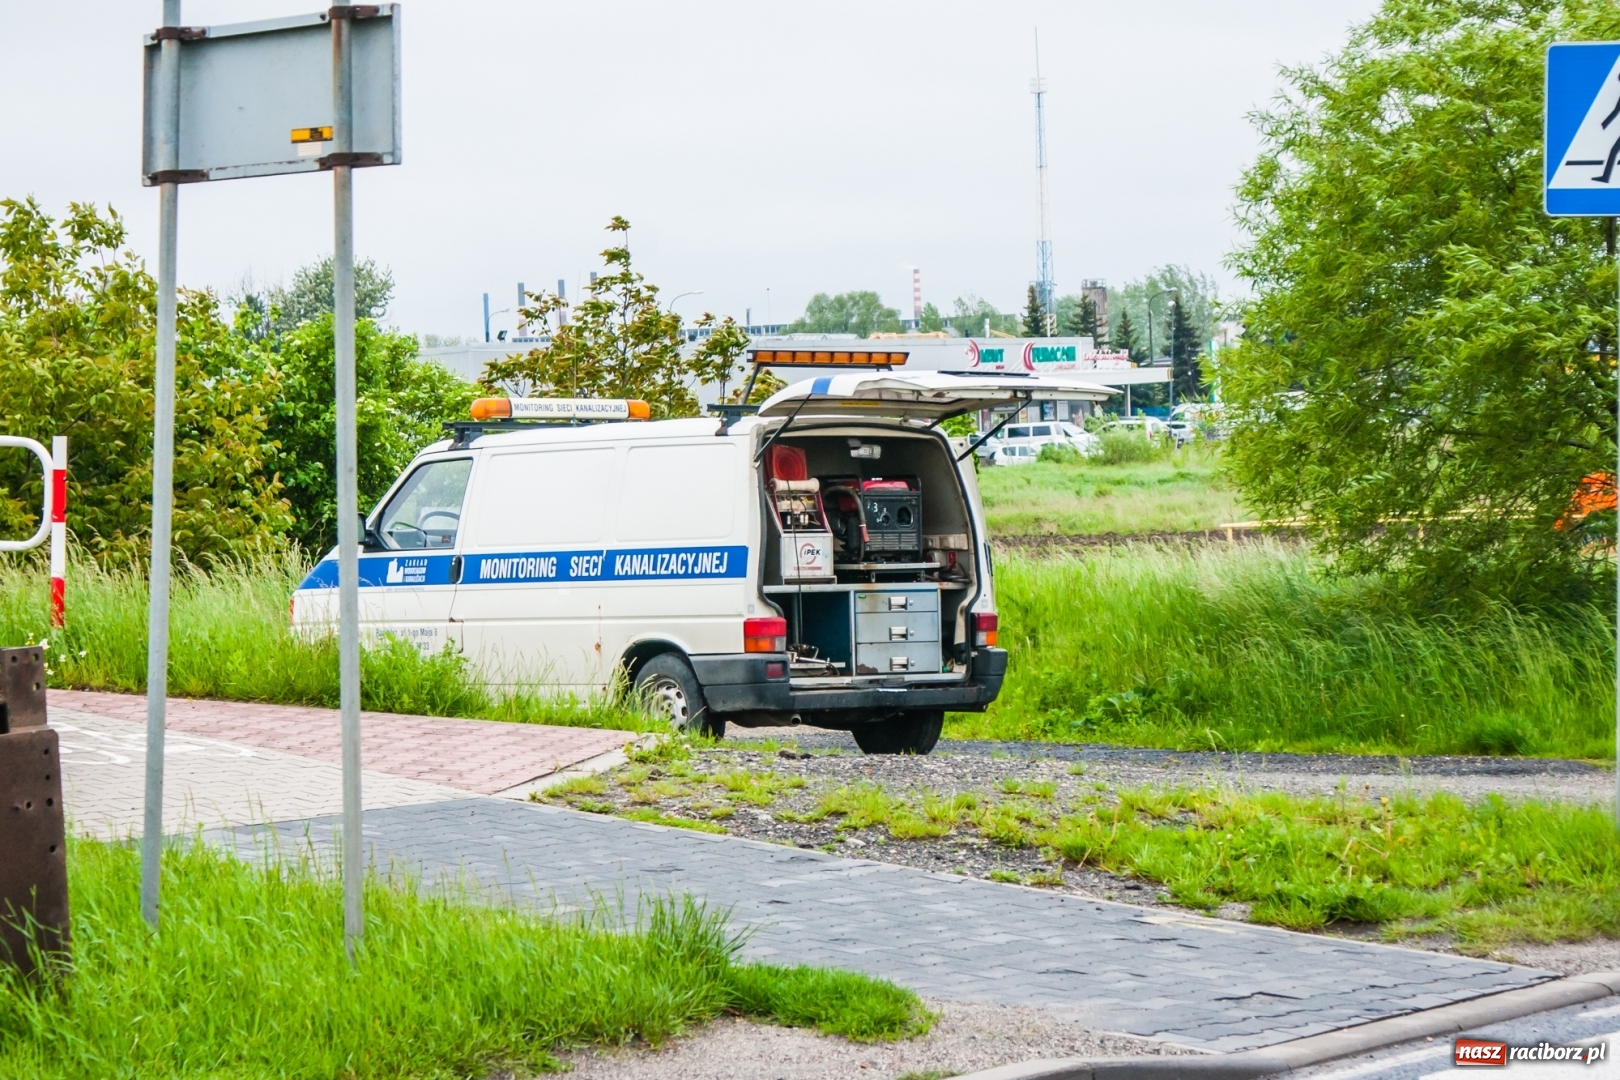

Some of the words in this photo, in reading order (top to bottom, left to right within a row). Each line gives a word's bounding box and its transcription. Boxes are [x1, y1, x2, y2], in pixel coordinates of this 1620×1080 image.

[514, 403, 554, 412] MONITORING
[557, 403, 573, 412] SIECI
[576, 403, 627, 412] KANALIZACYJNEJ
[479, 557, 557, 580] MONITORING
[569, 555, 603, 577] SIECI
[614, 552, 729, 576] KANALIZACYJNEJ
